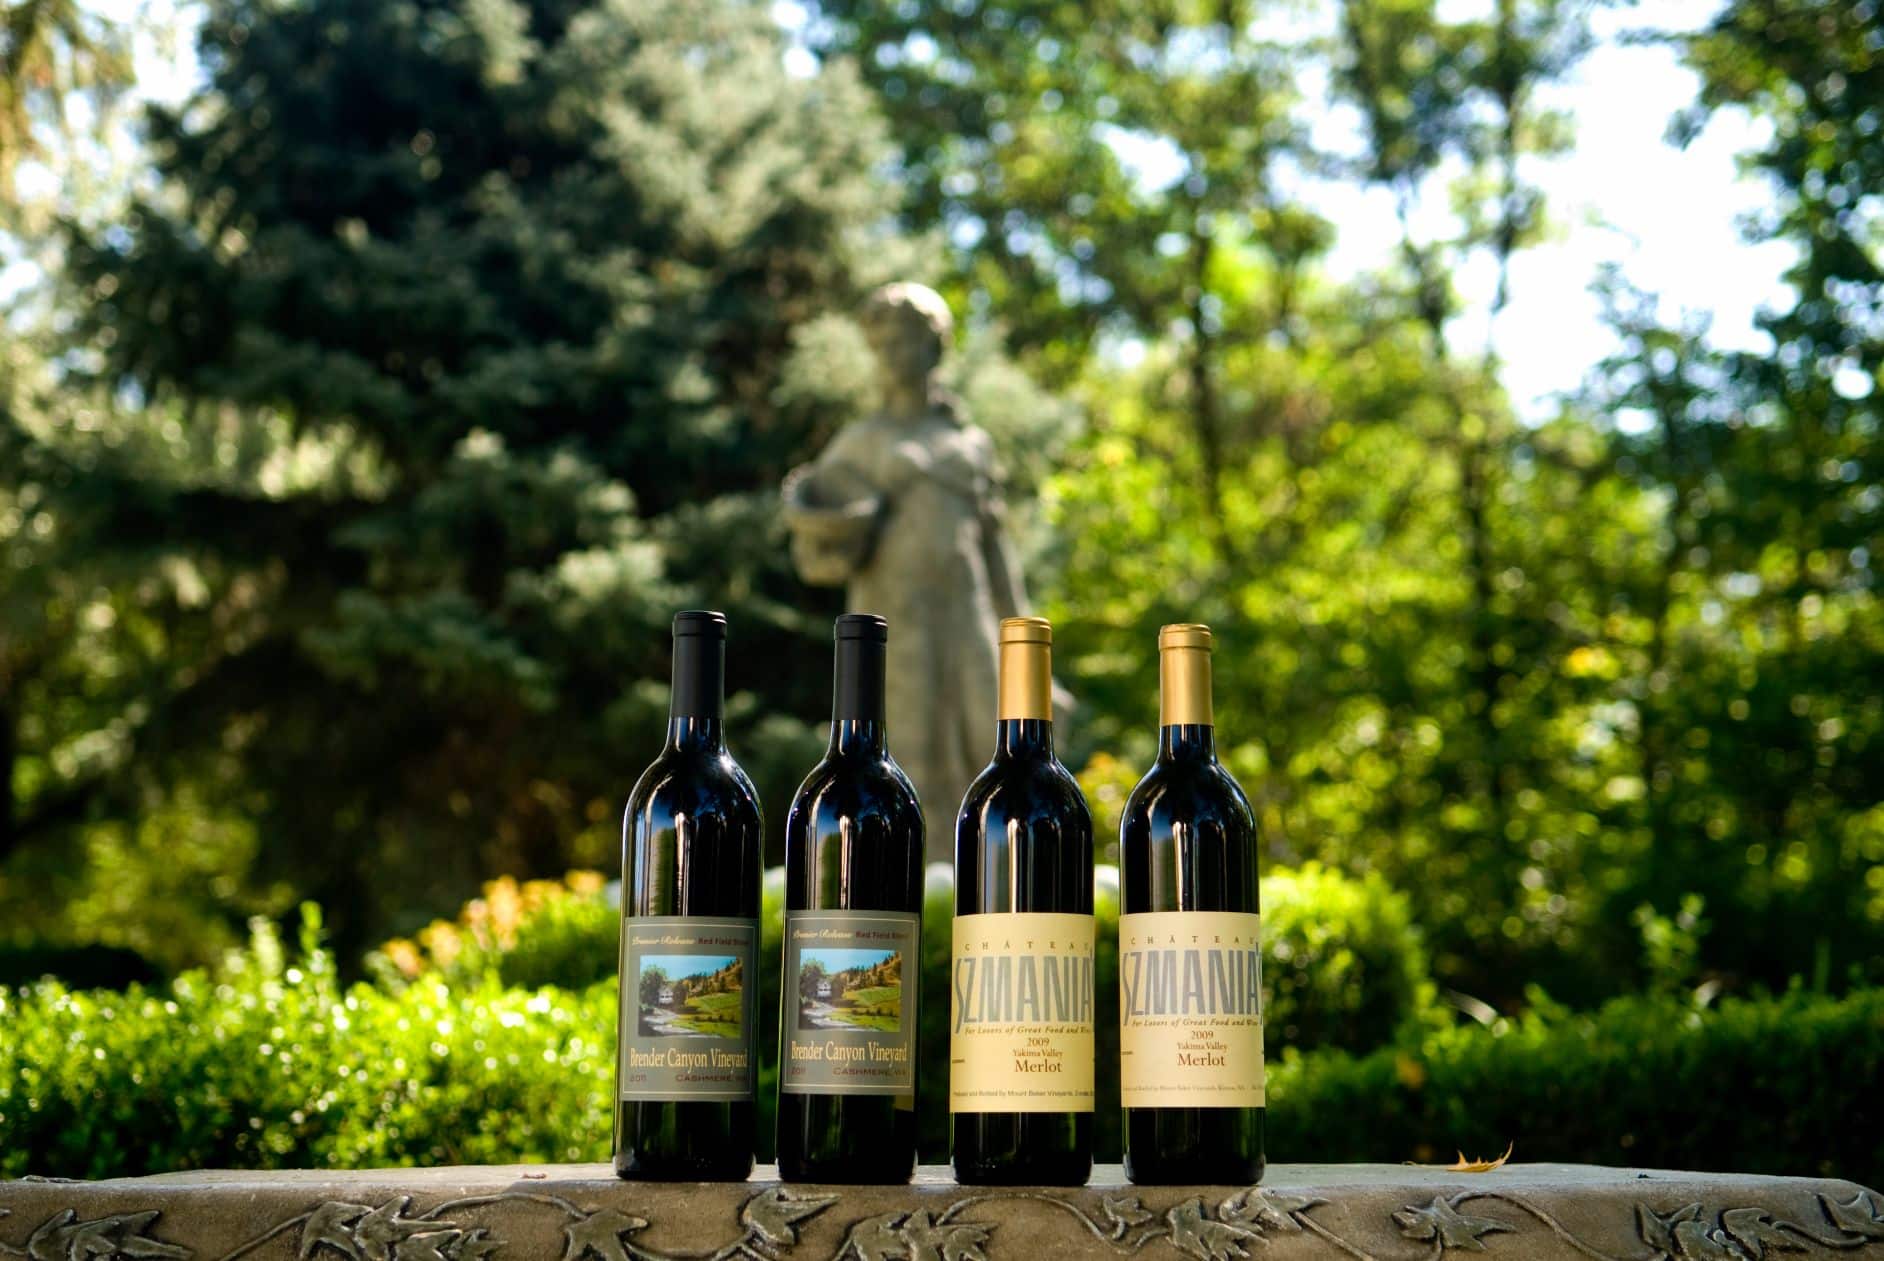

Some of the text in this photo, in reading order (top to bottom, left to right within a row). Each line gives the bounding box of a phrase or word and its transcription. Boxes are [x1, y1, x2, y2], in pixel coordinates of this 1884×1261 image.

[855, 930, 870, 939] Red
[1171, 1017, 1180, 1029] of
[1182, 1017, 1207, 1027] Great
[1210, 1018, 1229, 1027] Food
[1231, 1018, 1245, 1027] and
[1005, 1023, 1015, 1036] of
[1017, 1024, 1042, 1034] Great
[1045, 1025, 1064, 1034] Food
[1066, 1024, 1080, 1034] and
[1191, 1030, 1214, 1041] 2009
[1027, 1037, 1050, 1048] 2009
[1176, 1041, 1228, 1052] Yakima Valley
[791, 1040, 908, 1068] Brender Canyon Vineyard
[1013, 1048, 1063, 1060] Yakima Valley
[1177, 1052, 1226, 1067] Merlot
[630, 1047, 748, 1075] Brender Canyon Vineyard
[1015, 1058, 1063, 1073] Merlot
